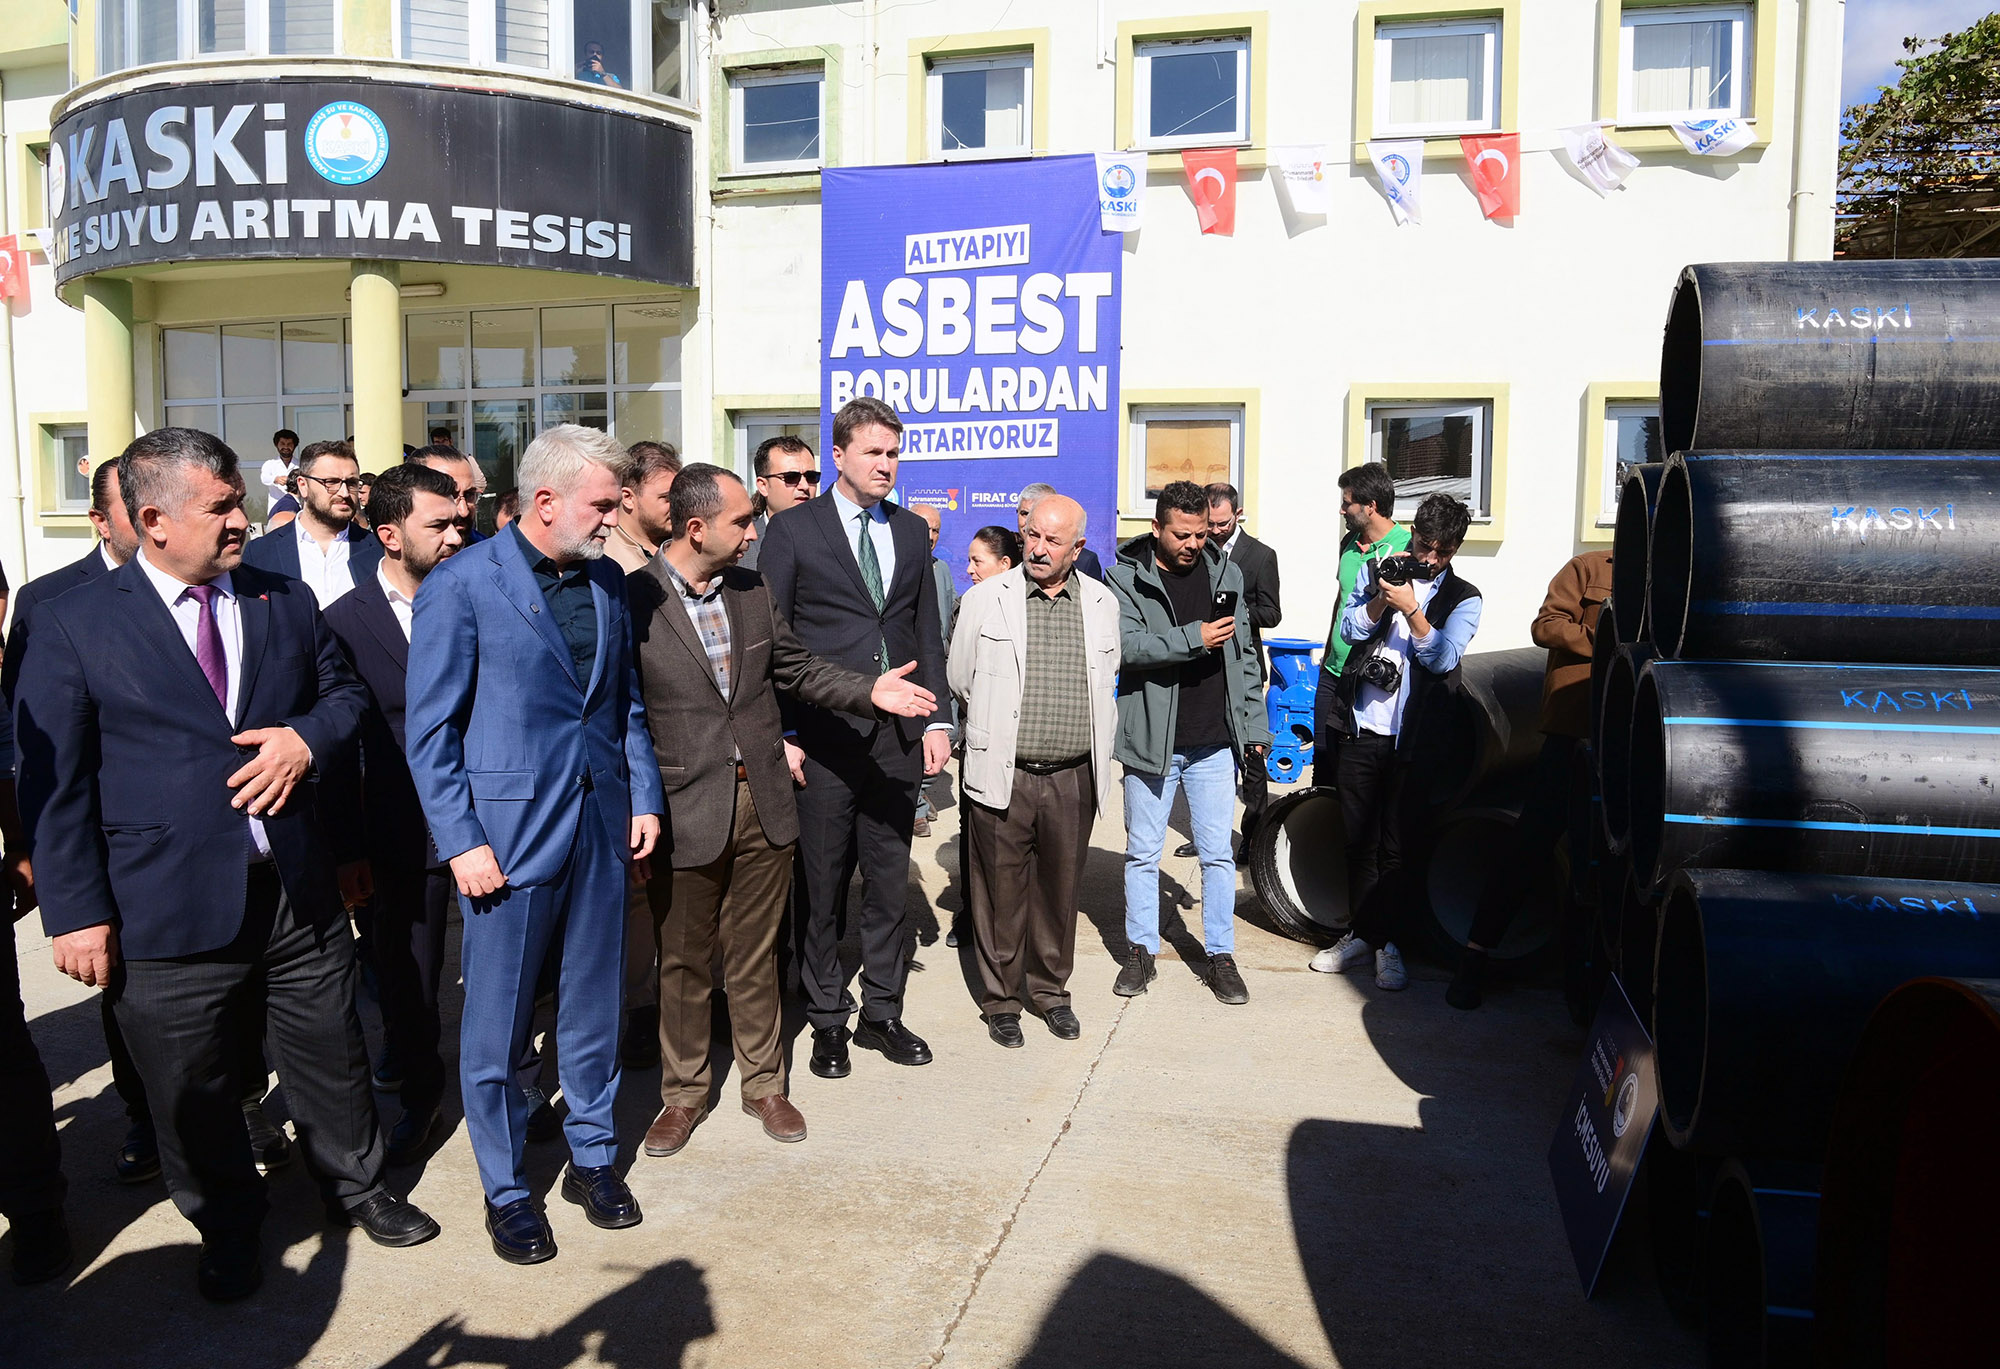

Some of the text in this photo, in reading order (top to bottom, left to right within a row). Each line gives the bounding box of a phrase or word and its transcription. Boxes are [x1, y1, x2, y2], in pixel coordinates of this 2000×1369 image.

[325, 105, 336, 115] SU
[85, 203, 179, 254] SUYU
[190, 199, 441, 242] ARITMA
[908, 230, 1025, 266] ALTYAPIYI
[829, 271, 1113, 359] ASBEST
[830, 365, 1108, 414] BORULARDAN
[899, 422, 1053, 454] URTARIYORUZ
[971, 492, 1007, 503] FIRAT
[1574, 1092, 1611, 1194] İÇMESUYU
